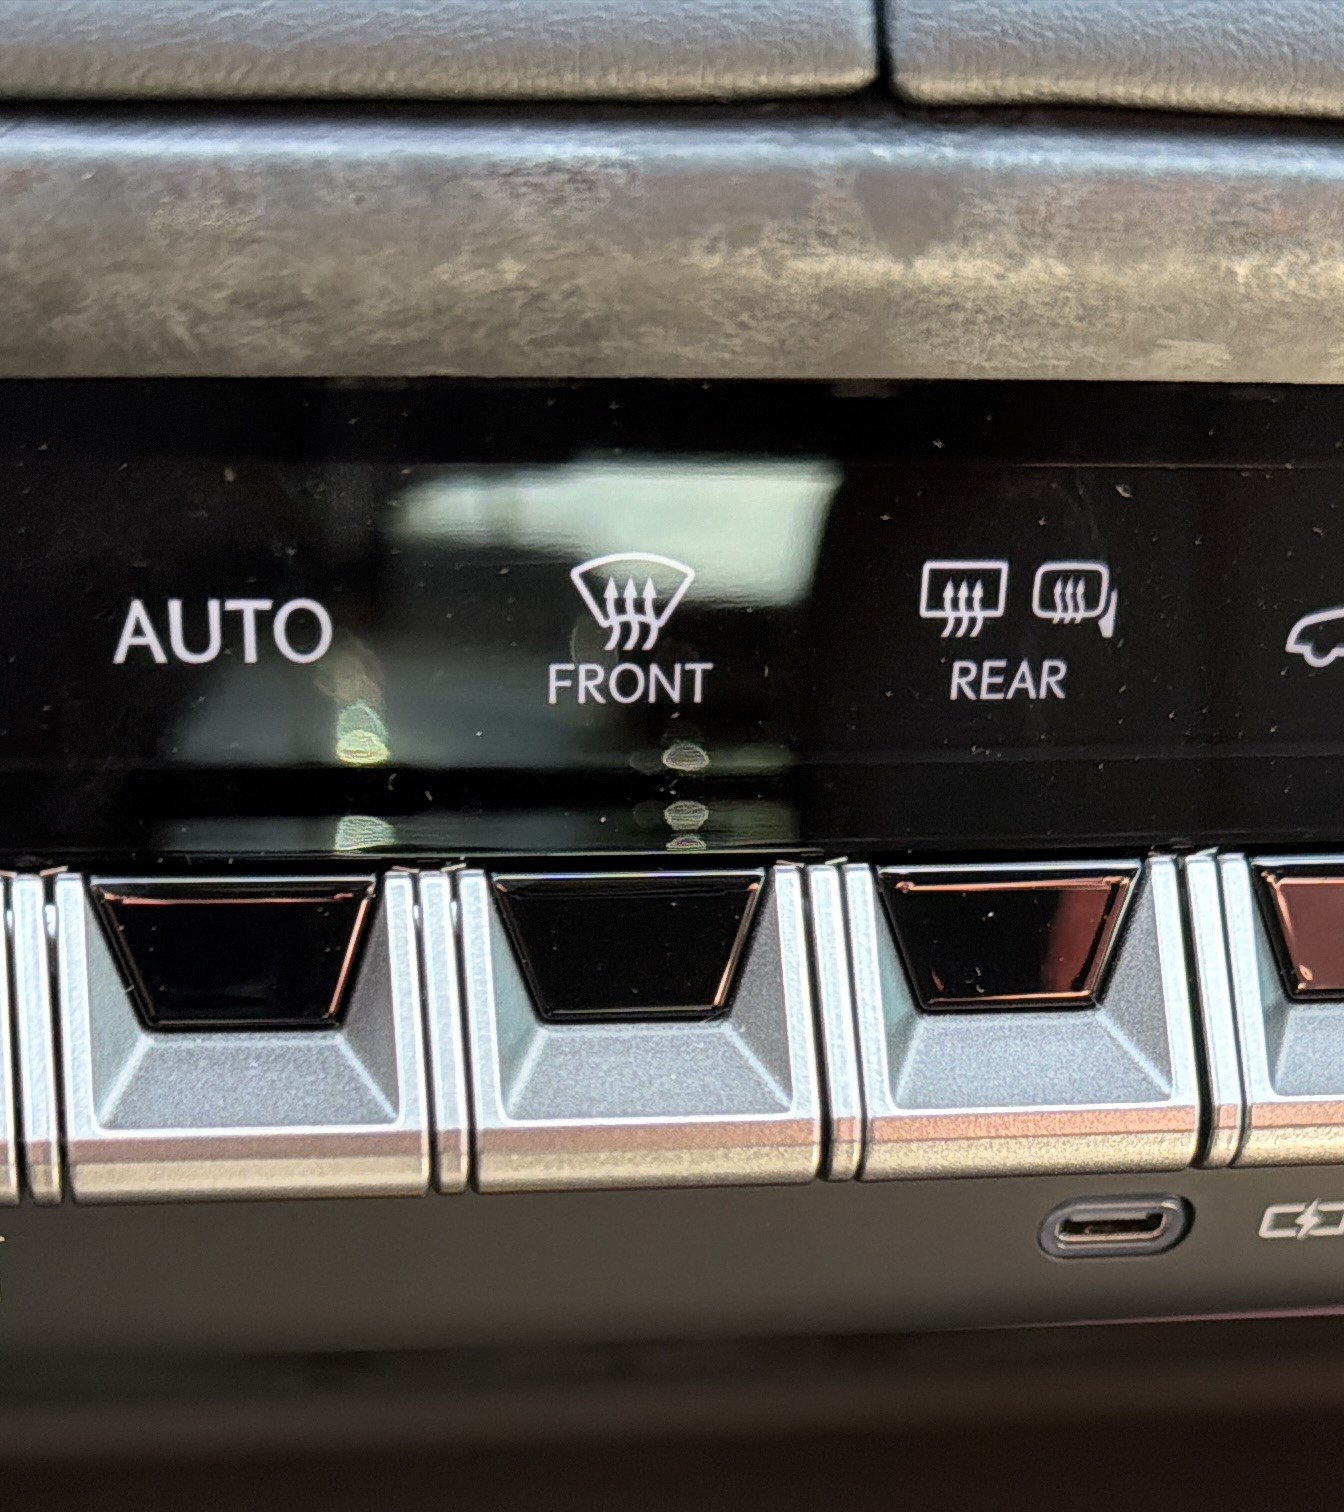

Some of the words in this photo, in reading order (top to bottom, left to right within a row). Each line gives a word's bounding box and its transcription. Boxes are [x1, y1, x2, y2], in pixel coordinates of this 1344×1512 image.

[113, 597, 334, 665] AUTO
[547, 661, 715, 706] FRONT
[948, 658, 1068, 702] REAR
